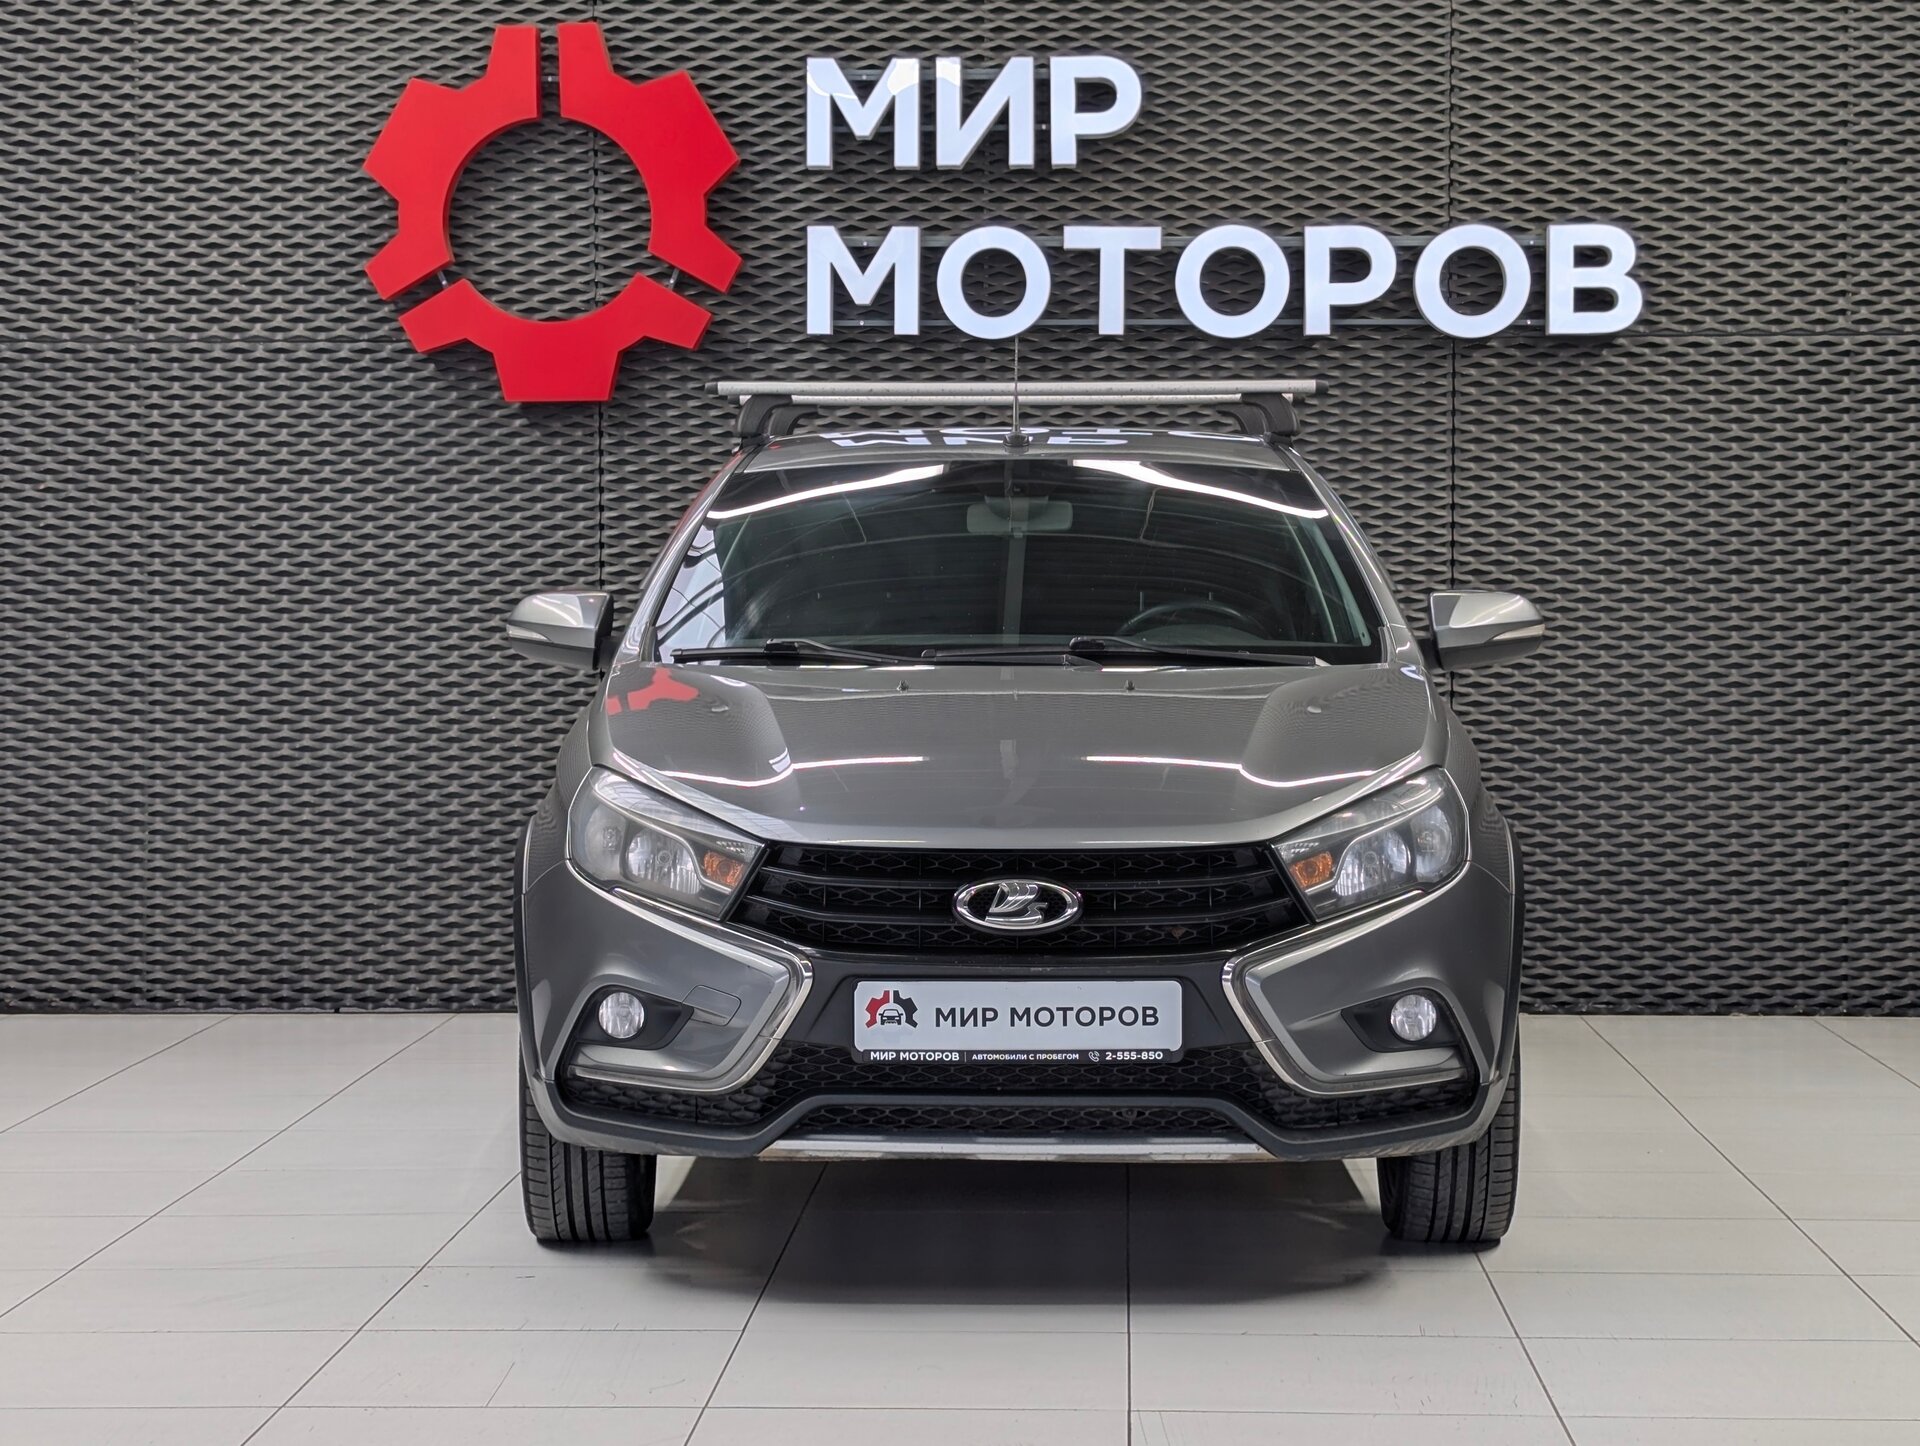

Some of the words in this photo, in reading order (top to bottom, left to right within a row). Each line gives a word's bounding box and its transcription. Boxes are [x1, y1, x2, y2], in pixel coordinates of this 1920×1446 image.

[806, 55, 1143, 169] МИР
[806, 223, 1643, 340] МОТОРОВ
[935, 1007, 999, 1027] МИР
[1010, 1006, 1159, 1027] МОТОРОВ
[870, 1051, 897, 1061] МИР
[899, 1051, 960, 1061] МОТОРОВ
[971, 1053, 1028, 1061] АВТОМОБИЛИ
[1028, 1053, 1035, 1061] С
[1036, 1052, 1080, 1060] ПРОБЕГОМ
[1105, 1050, 1164, 1060] 2-555-850
